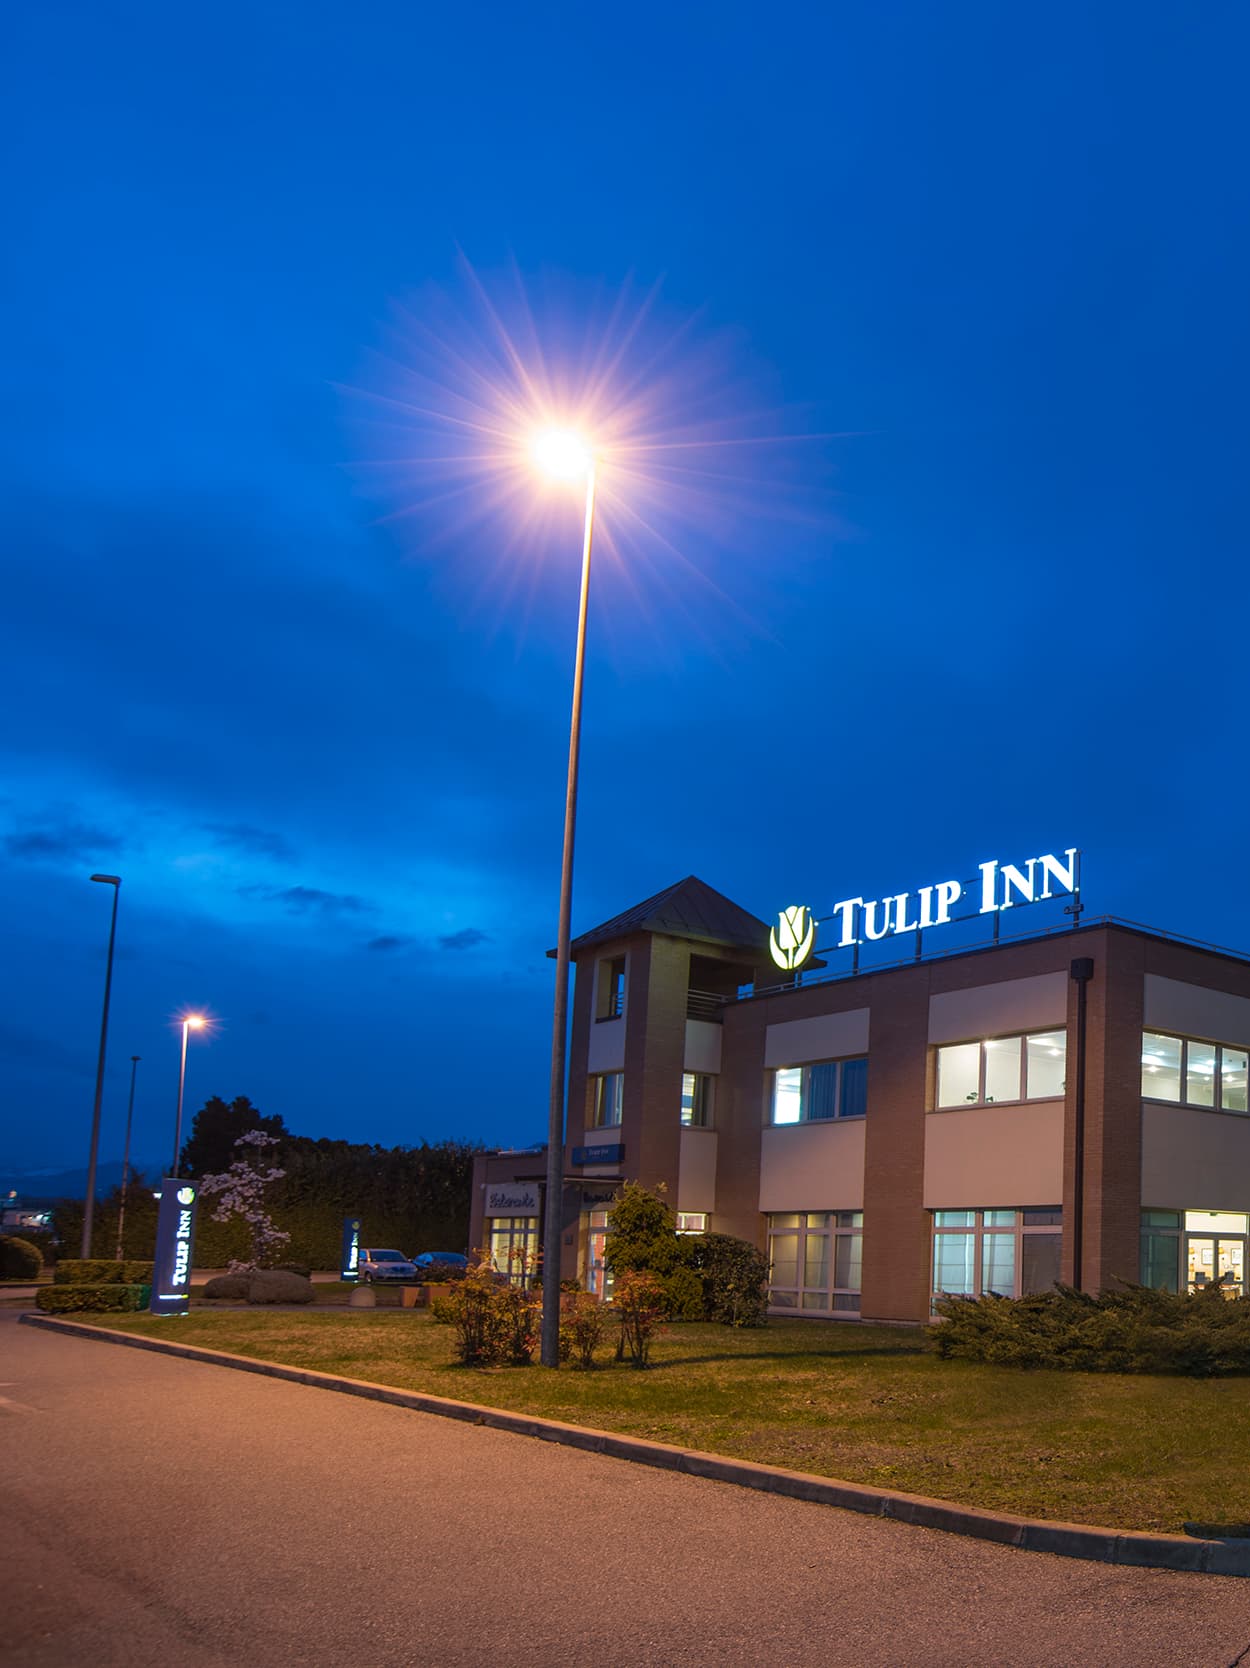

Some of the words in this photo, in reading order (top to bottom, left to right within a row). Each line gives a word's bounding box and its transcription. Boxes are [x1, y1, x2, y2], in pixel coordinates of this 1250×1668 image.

[833, 880, 961, 947] TULIP
[979, 848, 1079, 914] INN
[176, 1209, 192, 1238] INN
[172, 1241, 189, 1286] TULIP
